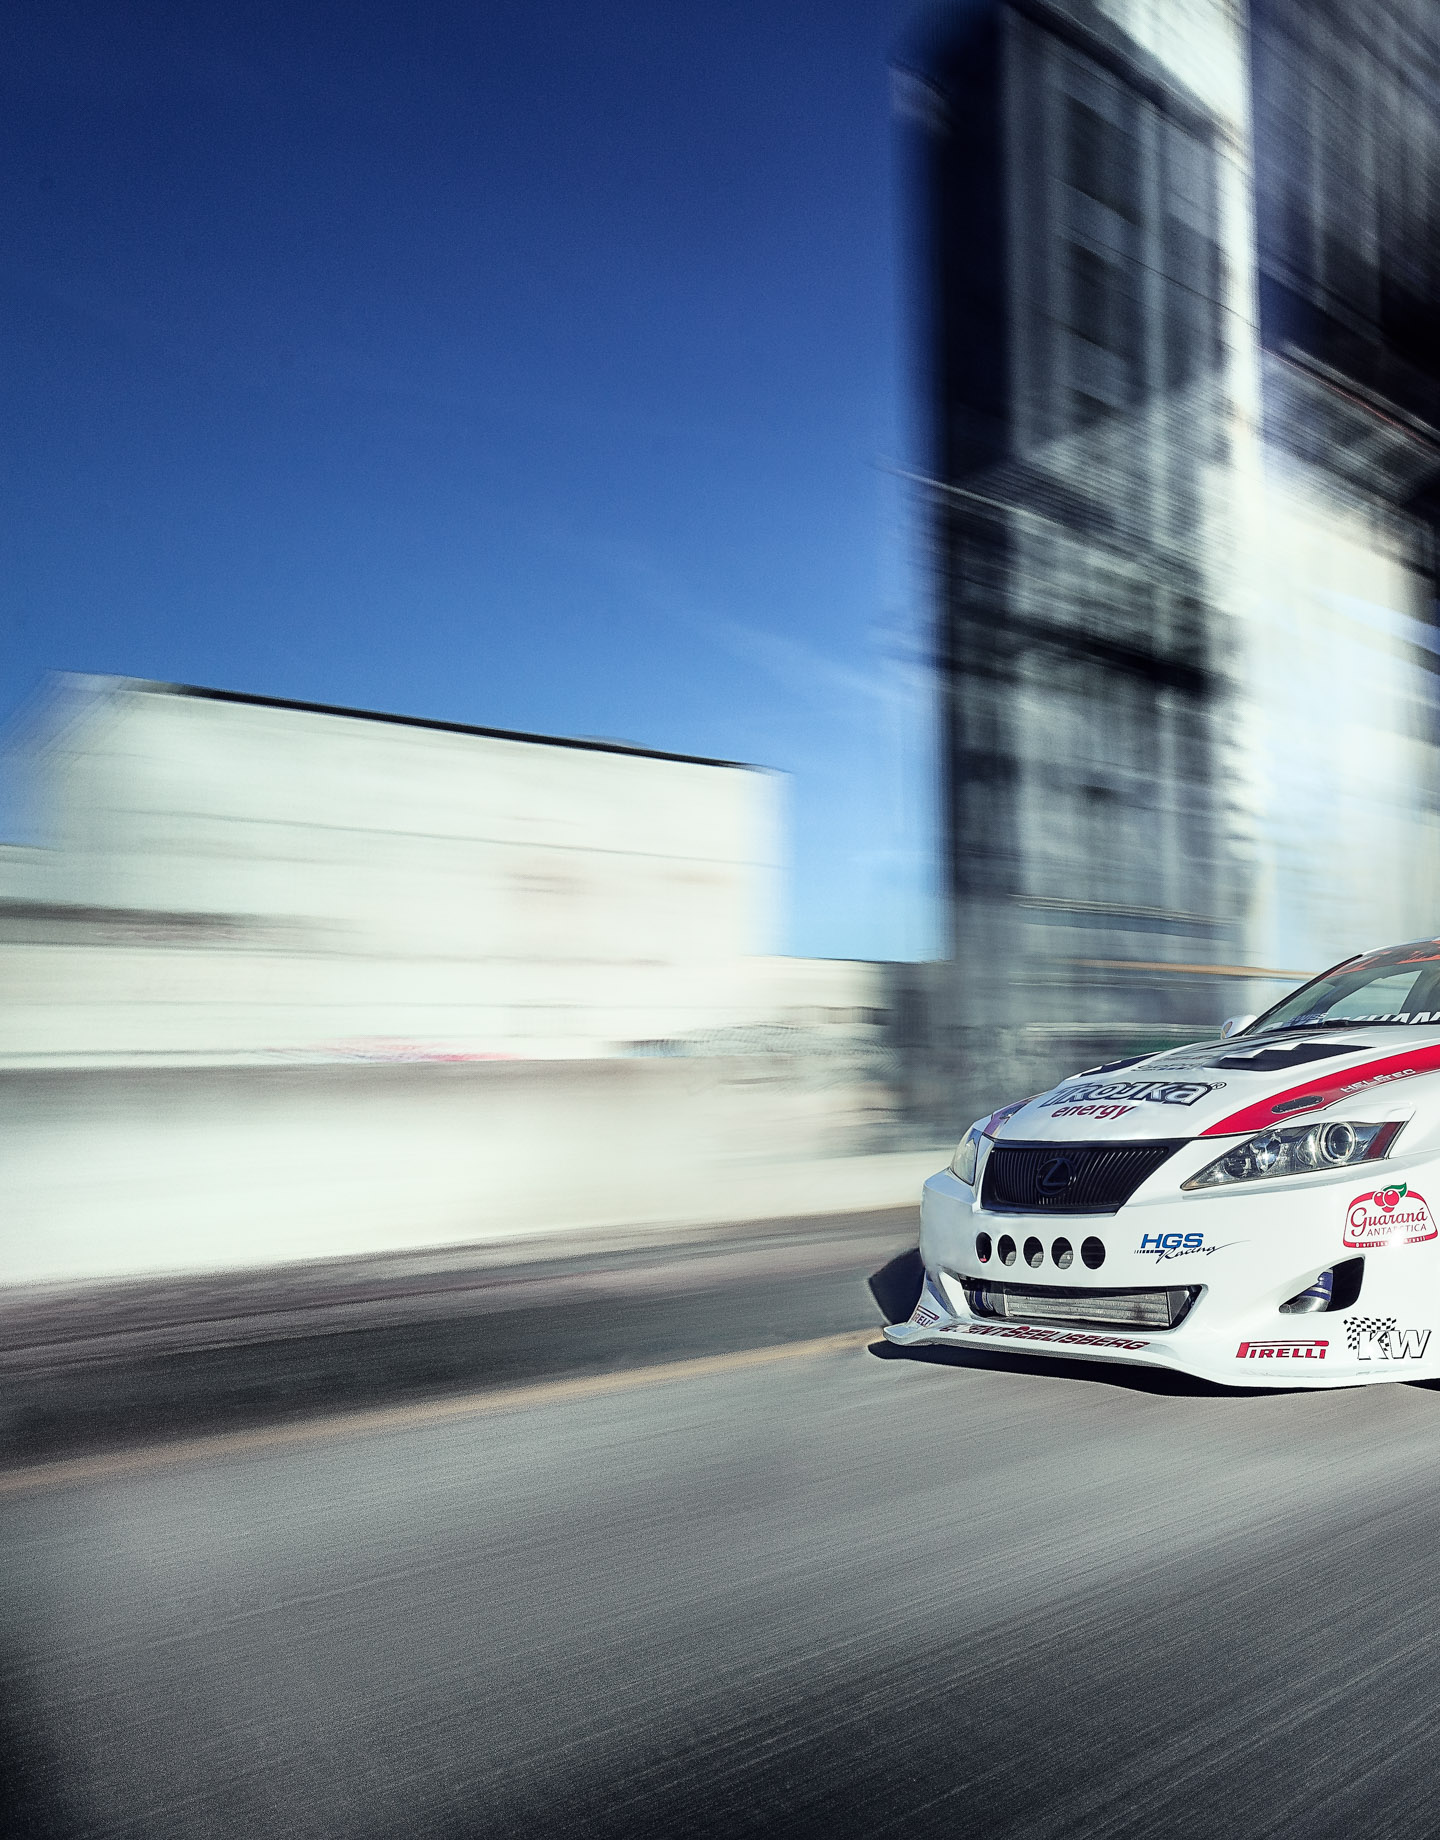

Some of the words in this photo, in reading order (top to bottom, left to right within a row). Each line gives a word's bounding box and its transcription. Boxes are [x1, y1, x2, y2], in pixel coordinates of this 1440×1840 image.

[1051, 1104, 1137, 1121] energy
[1350, 1206, 1428, 1238] Guaraná
[1366, 1223, 1427, 1237] ANTATICA
[1140, 1232, 1204, 1249] HGS
[1154, 1245, 1224, 1265] Racing
[910, 1304, 940, 1328] IRELLI
[1235, 1340, 1330, 1360] PIRELLI
[1357, 1328, 1433, 1361] KW
